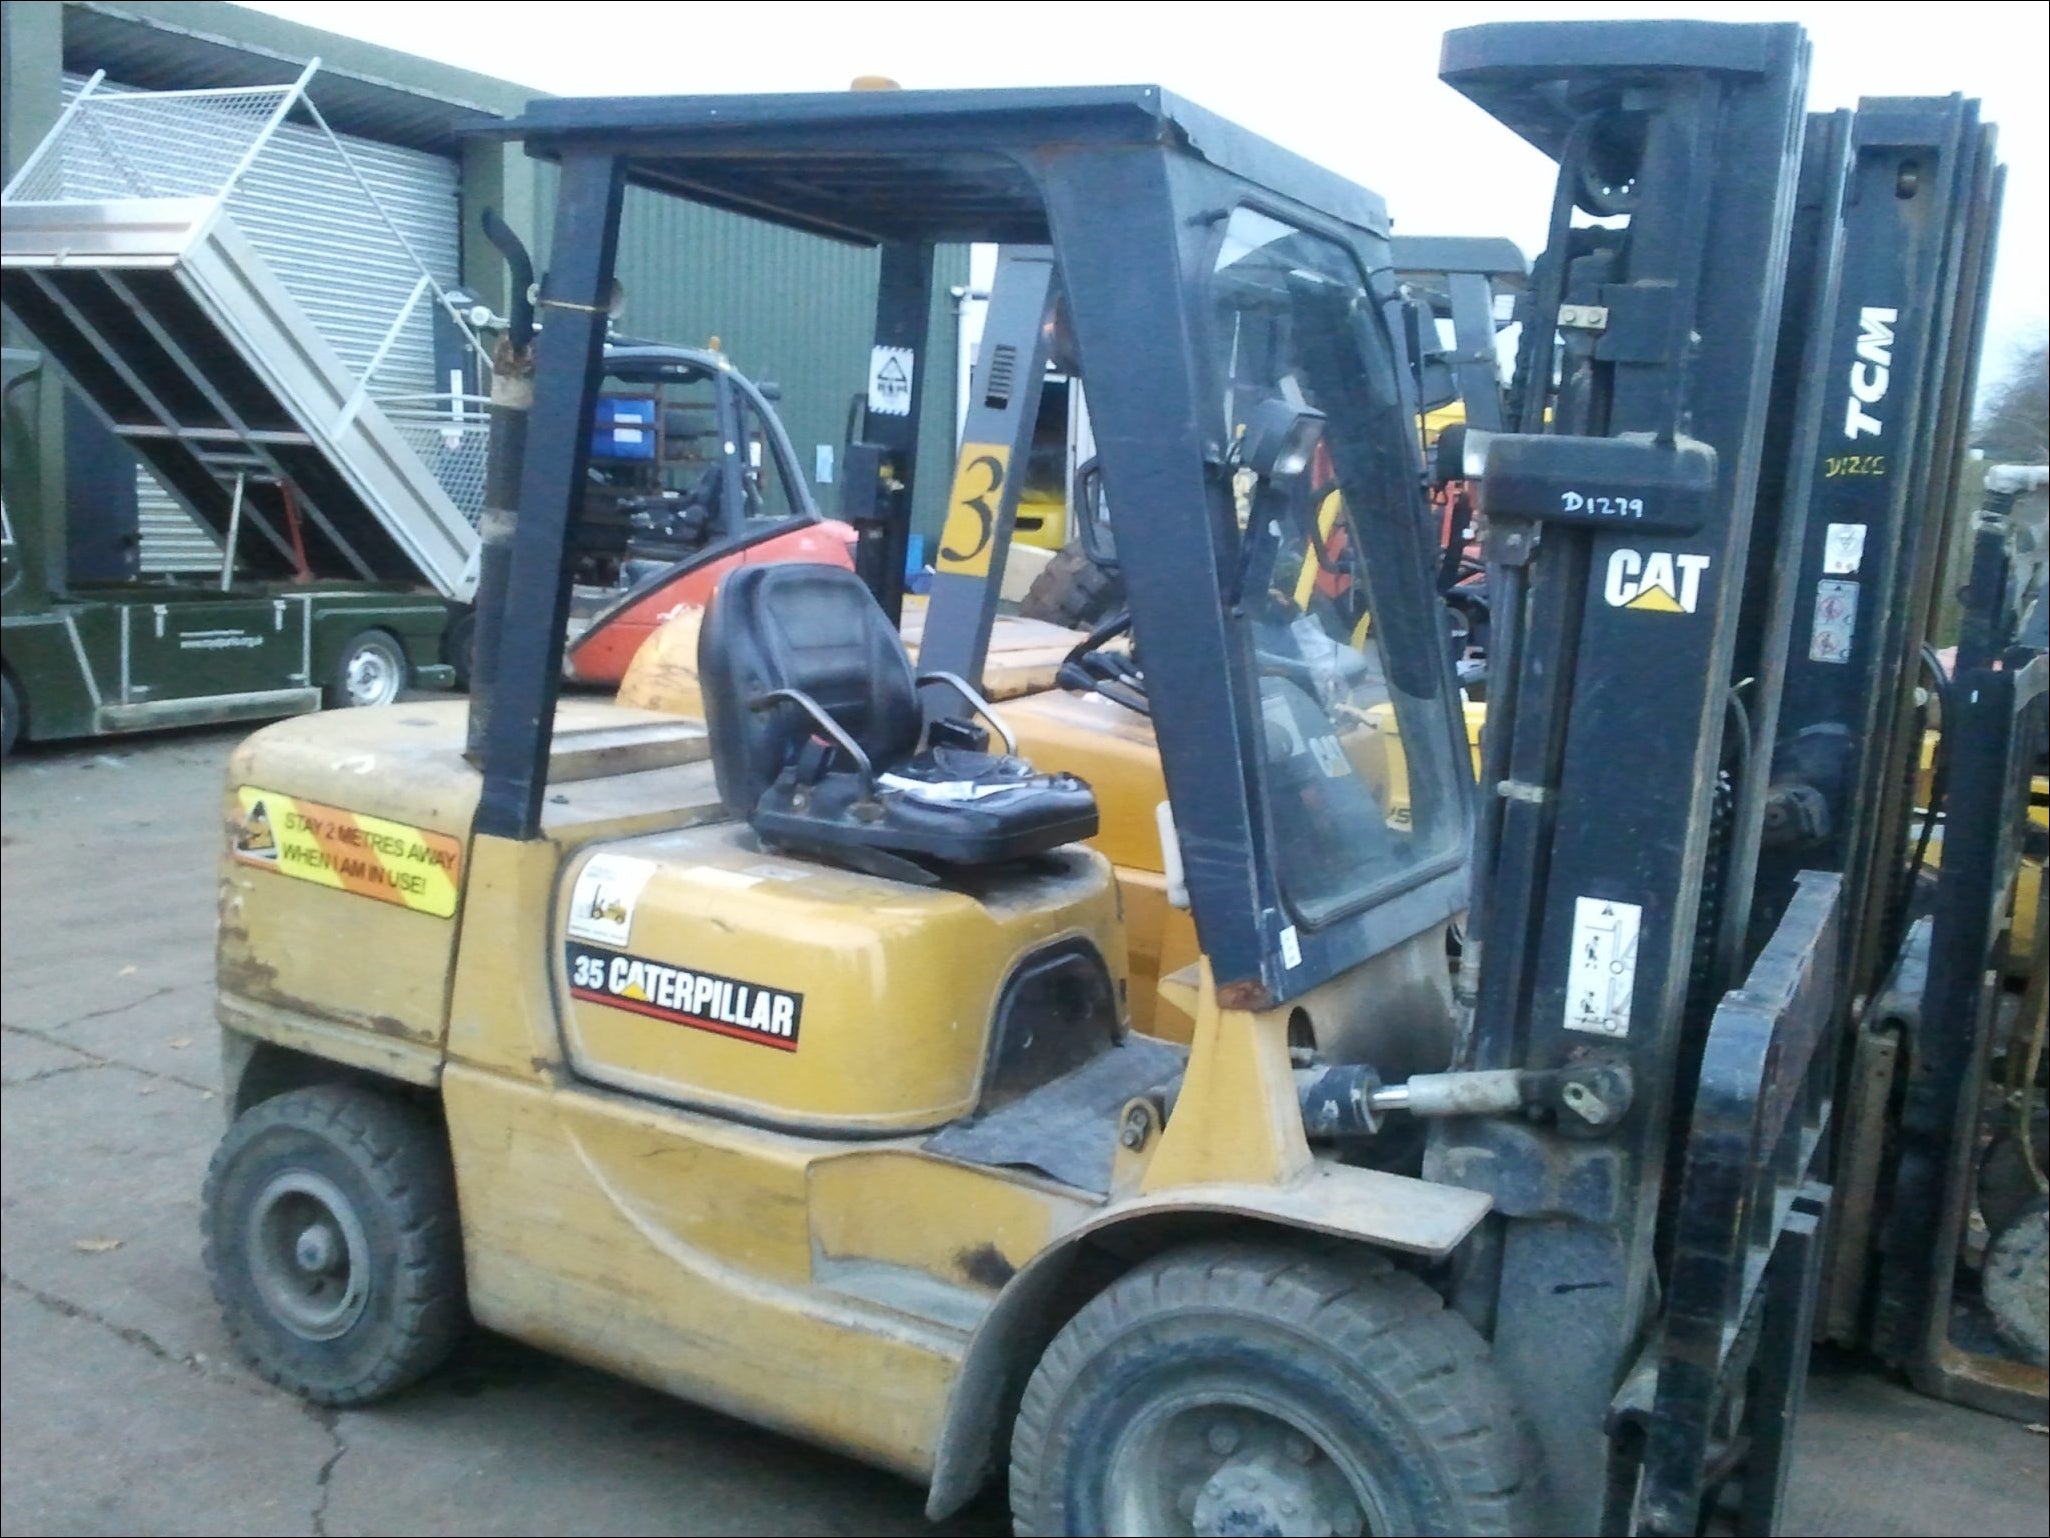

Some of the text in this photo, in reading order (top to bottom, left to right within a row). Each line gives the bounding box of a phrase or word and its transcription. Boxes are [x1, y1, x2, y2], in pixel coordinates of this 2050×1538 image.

[1844, 306, 1898, 440] TCM
[941, 455, 1003, 562] 3
[1561, 491, 1643, 517] D1279
[1604, 548, 1710, 613] CAT
[283, 812, 456, 869] STAY 2 METRES AWAY
[283, 843, 332, 870] WHEN
[340, 859, 366, 879] AM
[368, 863, 384, 883] IN
[388, 871, 427, 895] USE!
[573, 955, 795, 1037] 35 CATERPILLAR
